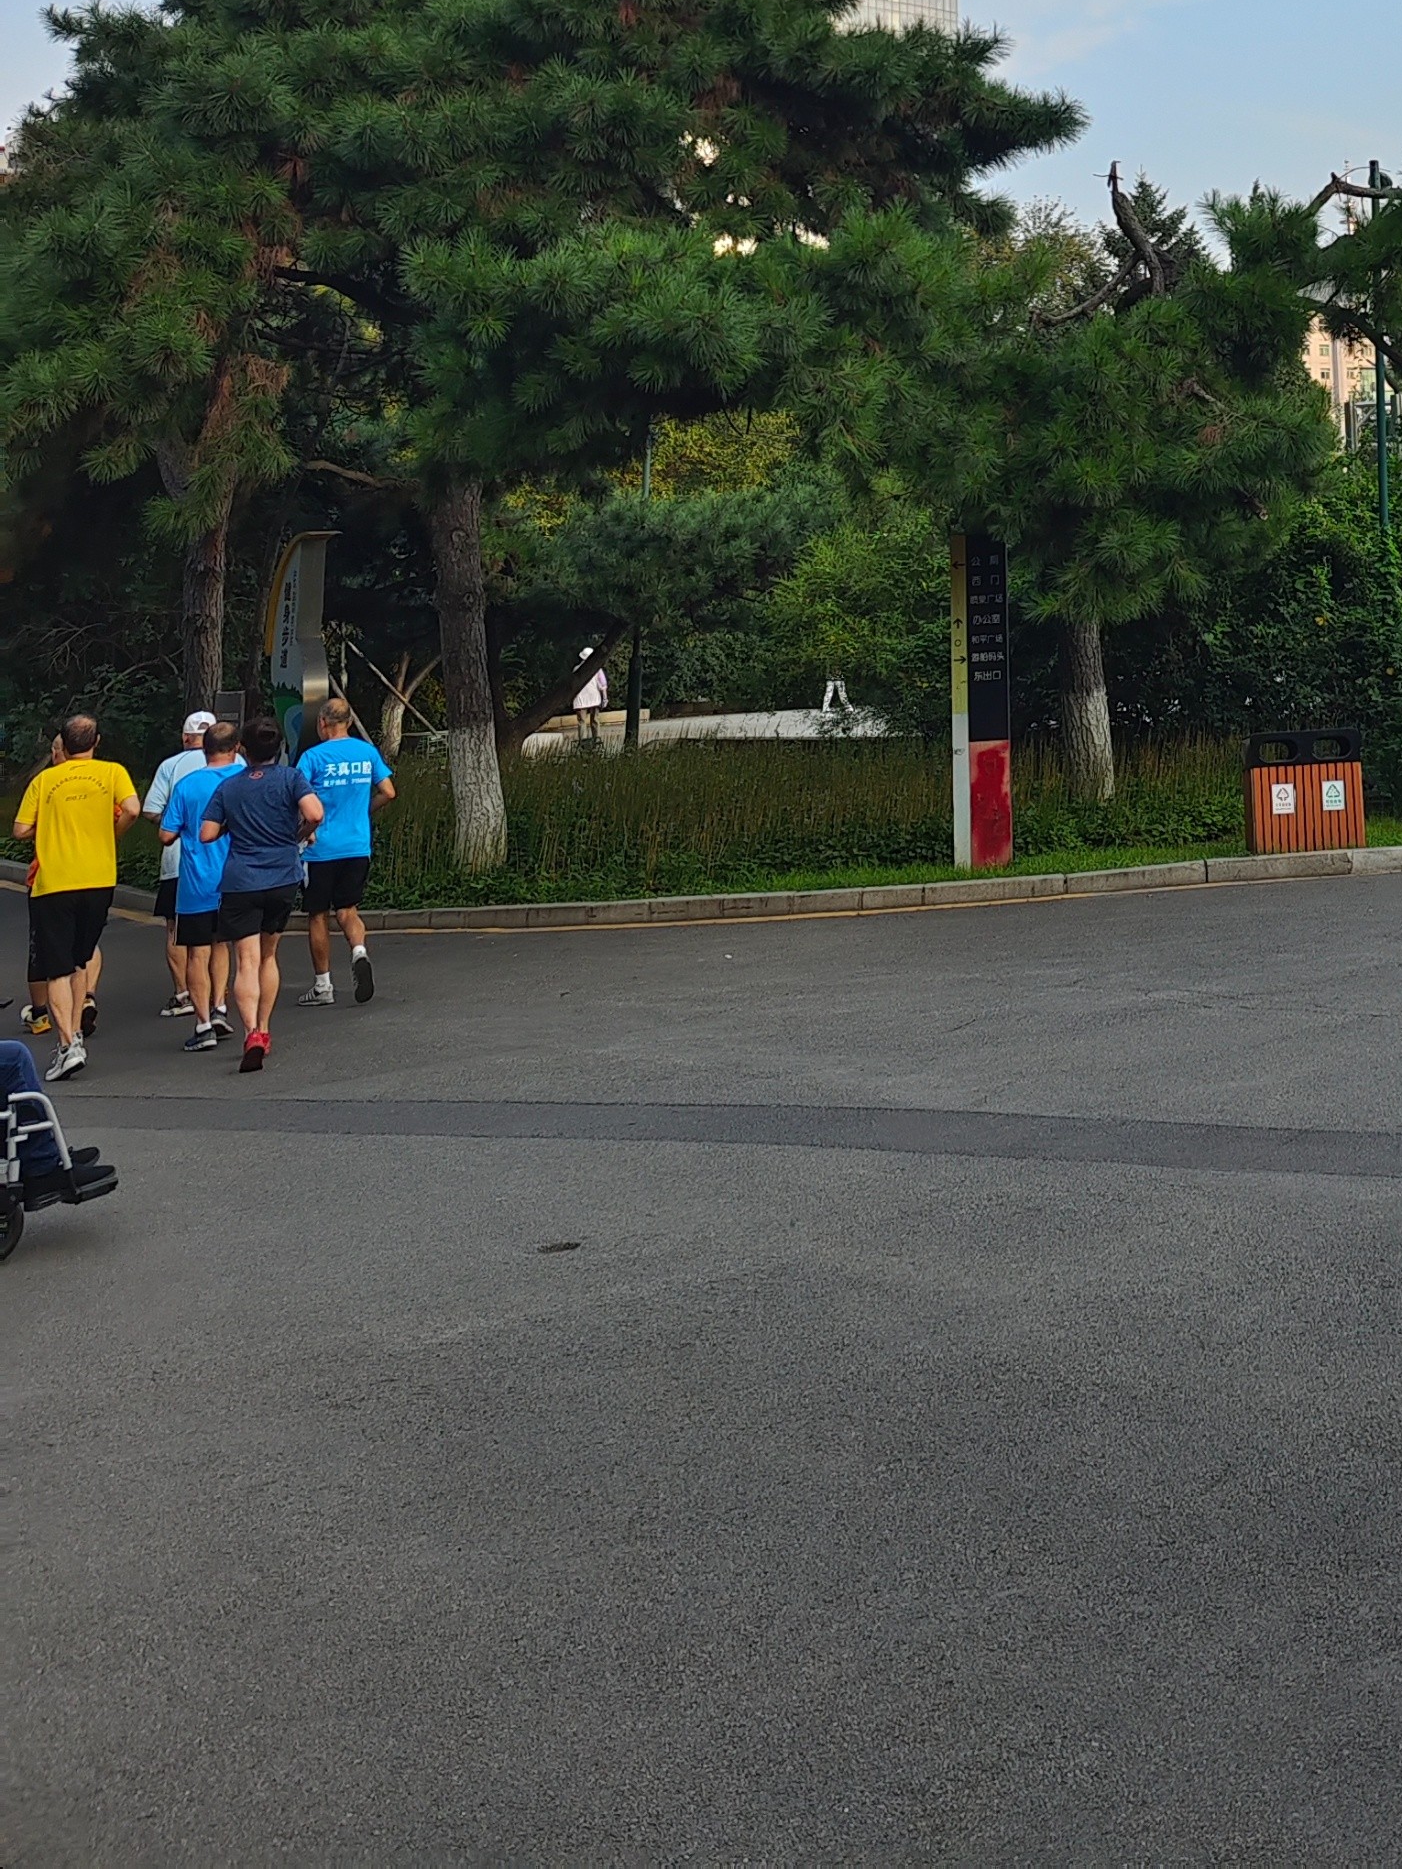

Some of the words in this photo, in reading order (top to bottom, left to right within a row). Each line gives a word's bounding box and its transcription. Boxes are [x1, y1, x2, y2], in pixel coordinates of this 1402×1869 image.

[973, 614, 1000, 625] 办公室
[971, 633, 1003, 644] 和平广场
[974, 670, 1002, 681] 东出口
